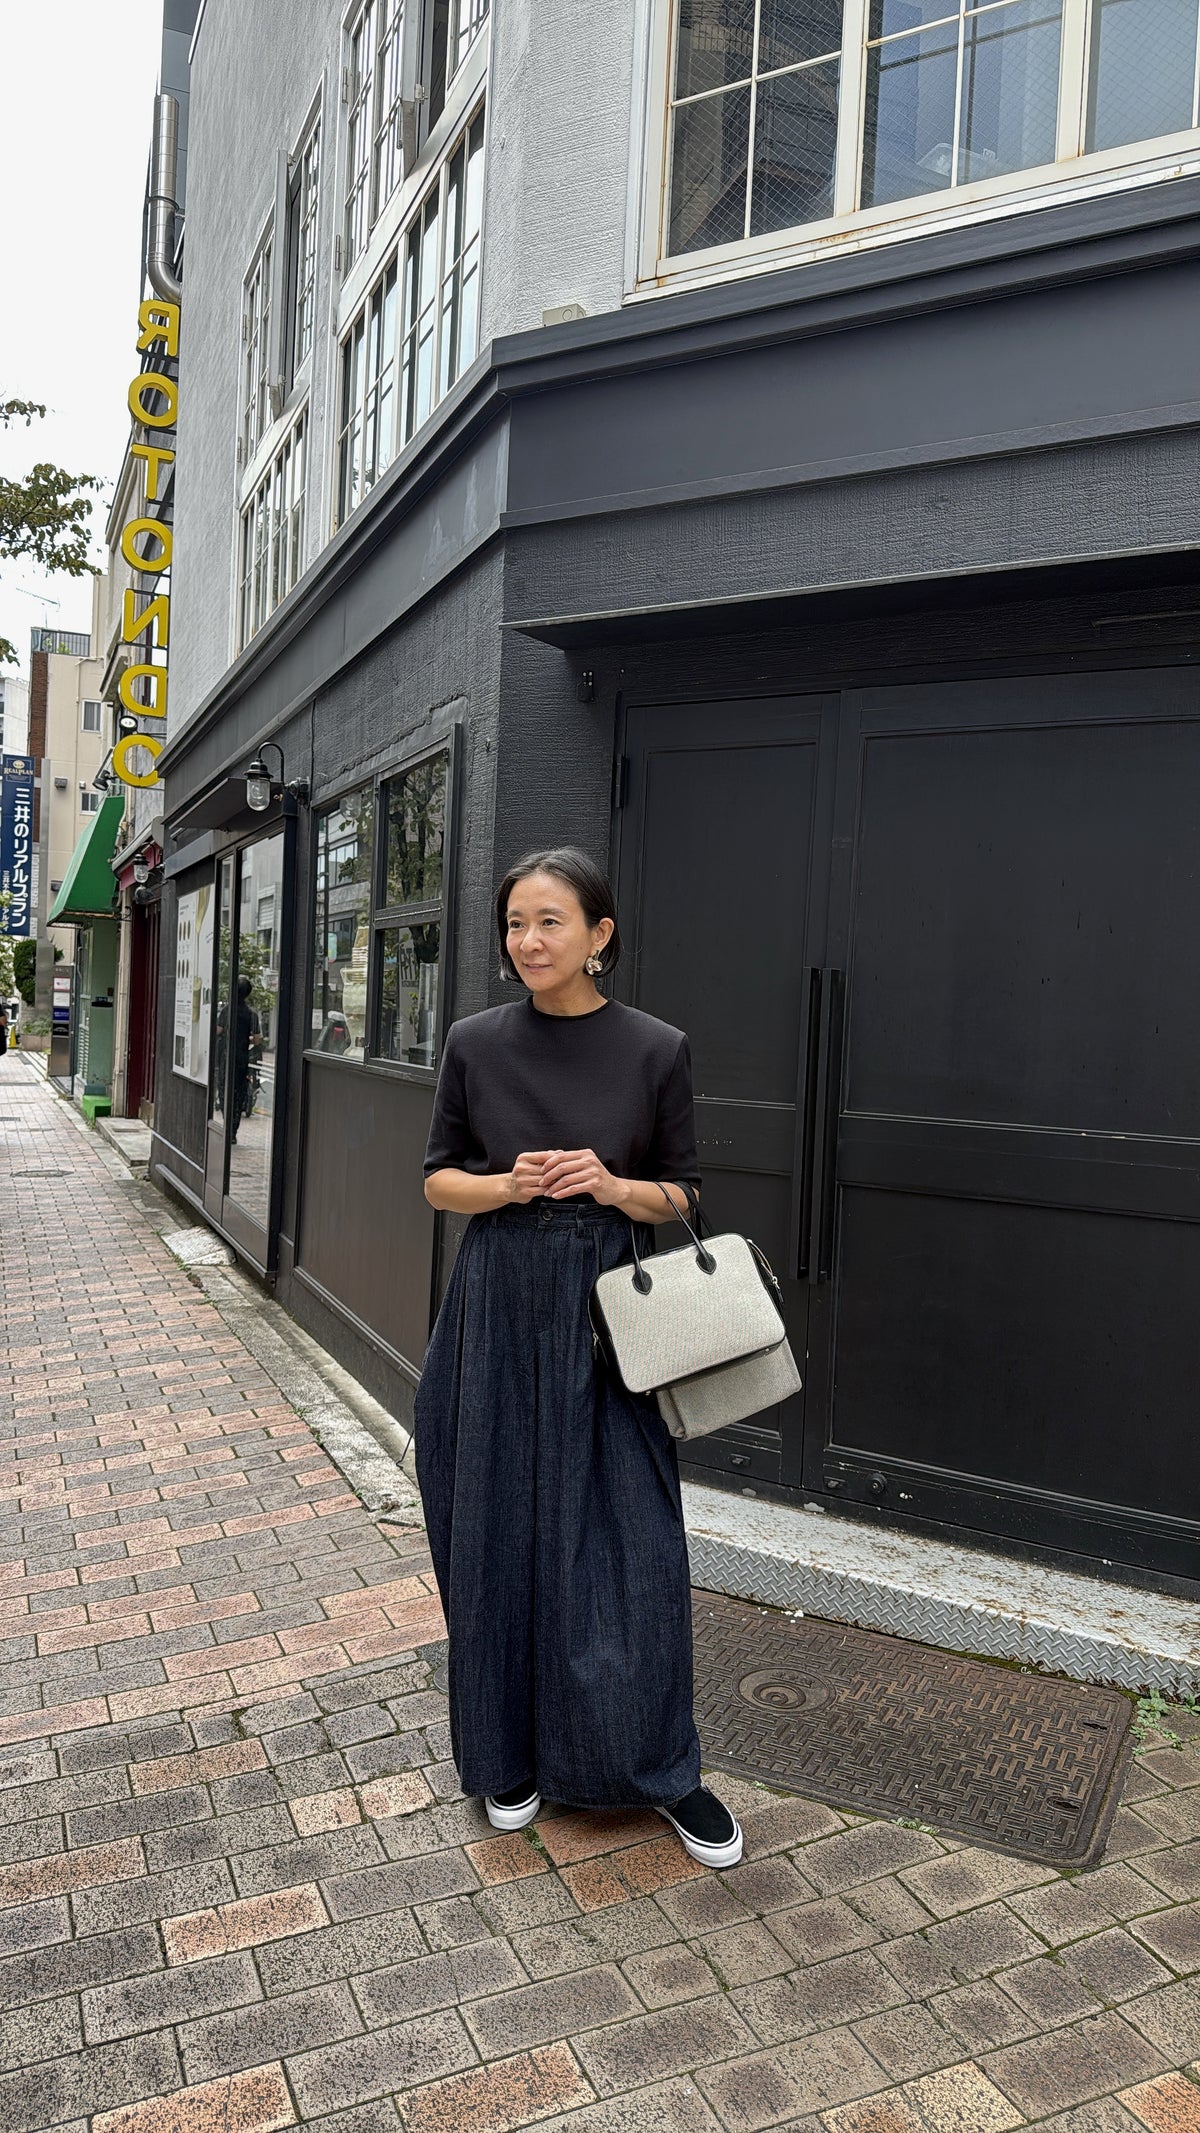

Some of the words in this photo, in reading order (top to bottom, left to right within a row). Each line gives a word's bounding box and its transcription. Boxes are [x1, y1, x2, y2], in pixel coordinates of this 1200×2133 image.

[4, 767, 34, 776] REALPLAN
[12, 787, 31, 928] 三井のリアルプラン
